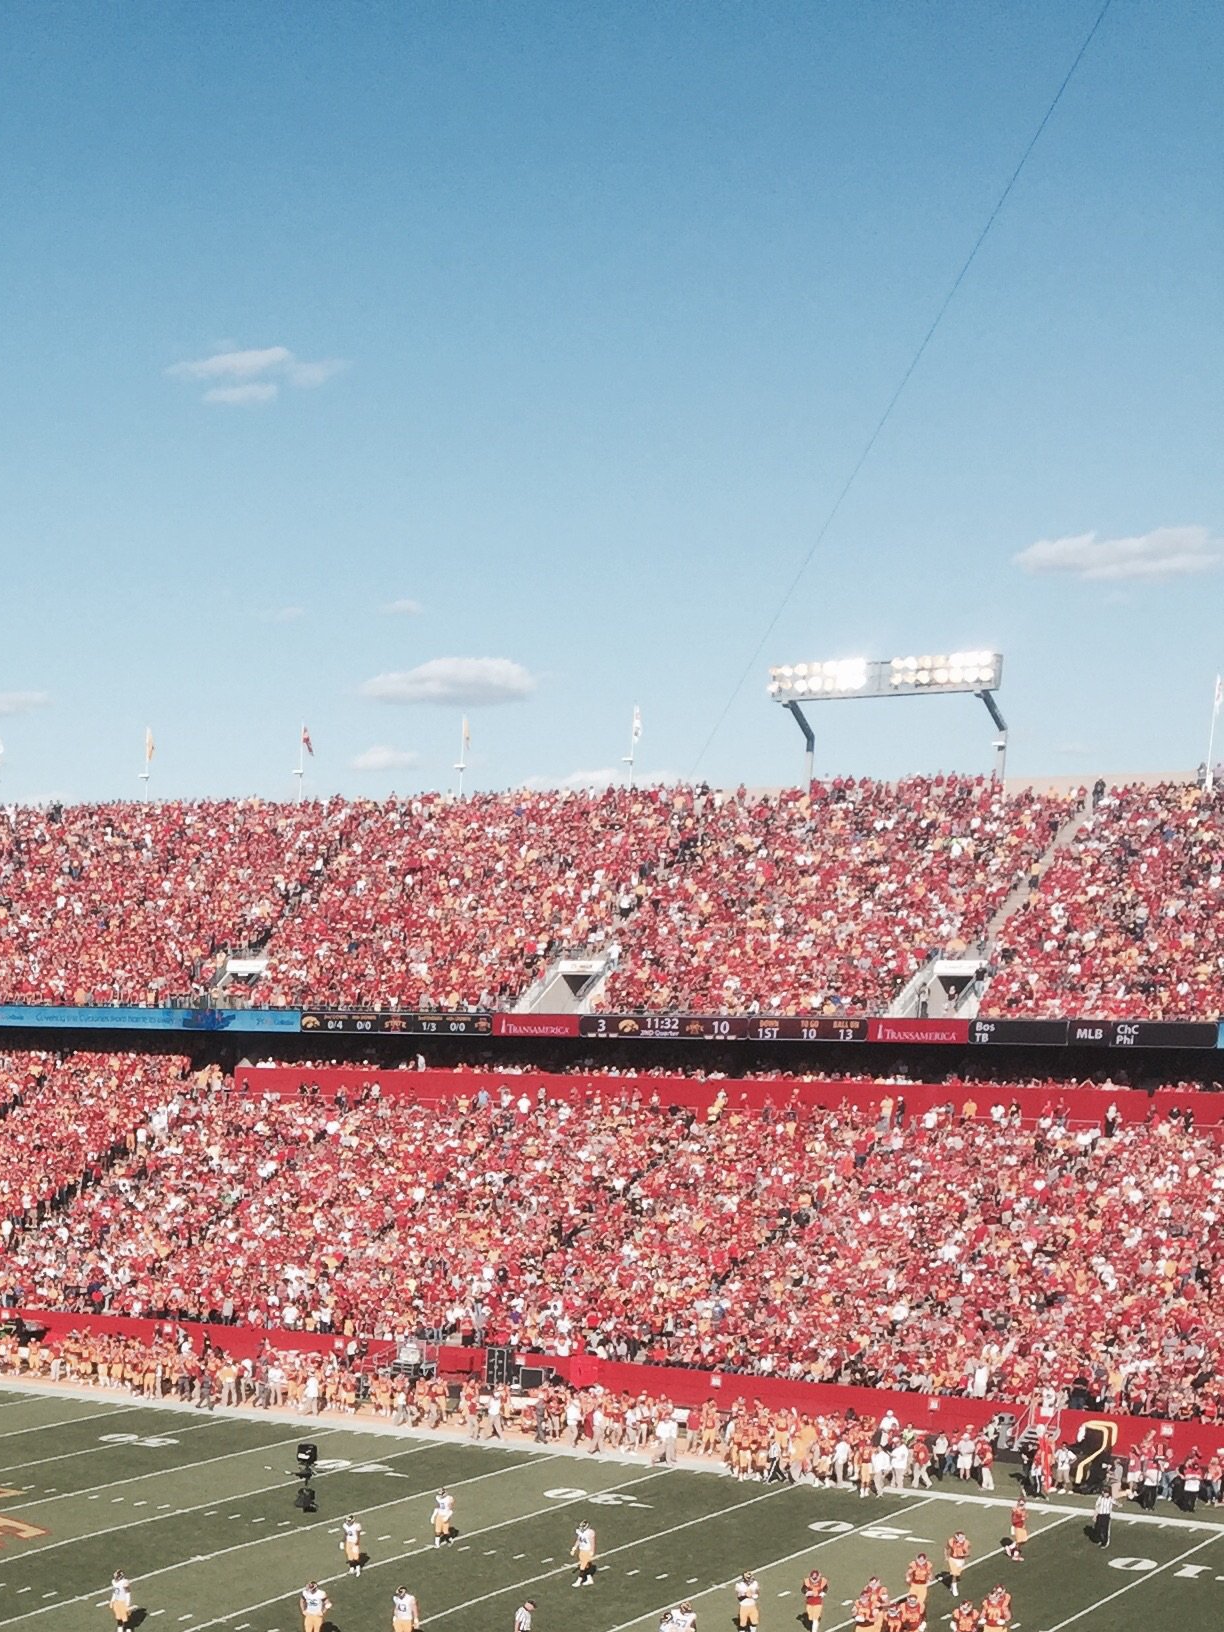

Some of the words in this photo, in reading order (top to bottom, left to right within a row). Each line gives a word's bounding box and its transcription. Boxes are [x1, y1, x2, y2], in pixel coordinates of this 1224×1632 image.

[598, 1021, 607, 1032] 3
[645, 1017, 680, 1029] 11:32
[712, 1021, 730, 1034] 10
[975, 1022, 996, 1032] Bos
[758, 1028, 779, 1039] 1ST
[801, 1028, 817, 1039] 10
[838, 1029, 853, 1040] 13
[885, 1029, 957, 1041] TRANSAMERICA
[1076, 1028, 1104, 1040] MLB
[1117, 1024, 1139, 1035] ChC
[975, 1033, 989, 1042] TB
[1116, 1035, 1134, 1045] Phi
